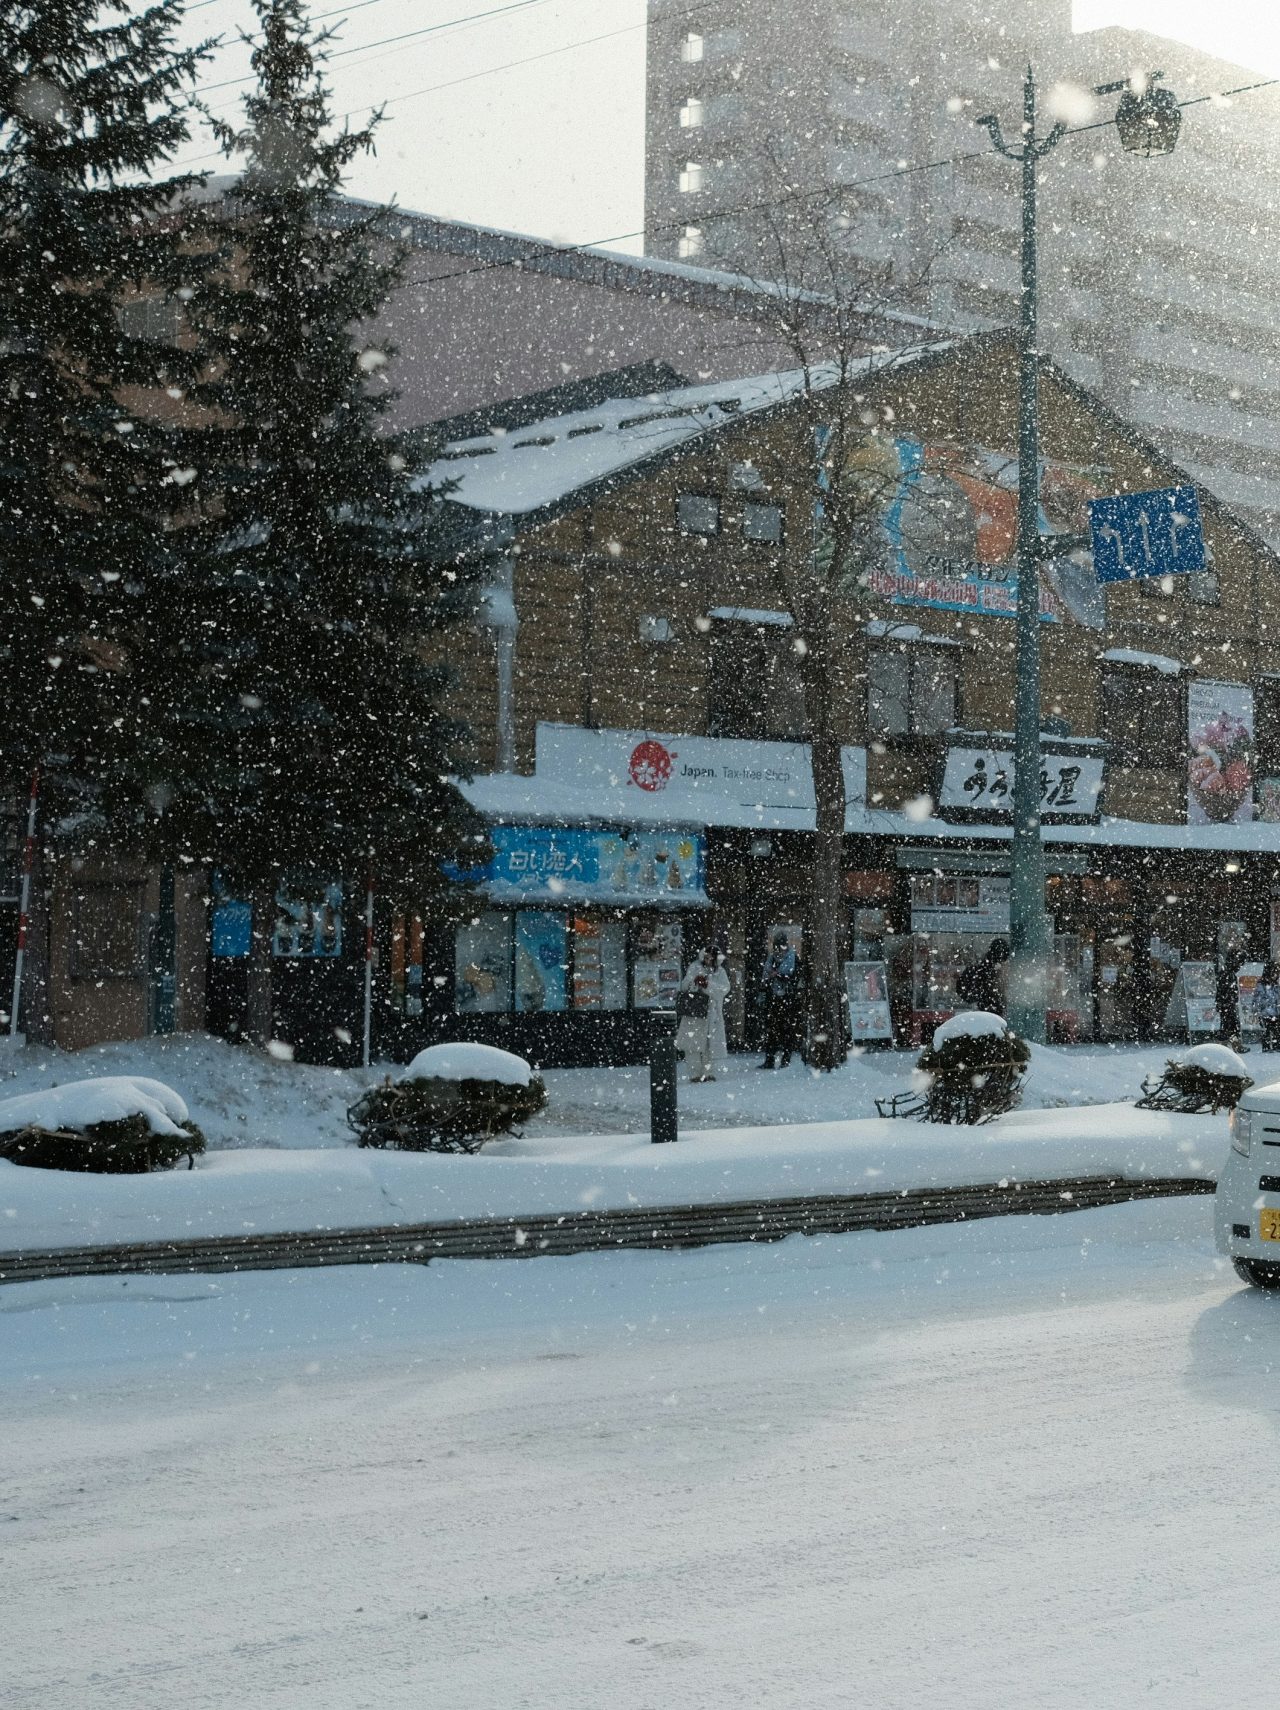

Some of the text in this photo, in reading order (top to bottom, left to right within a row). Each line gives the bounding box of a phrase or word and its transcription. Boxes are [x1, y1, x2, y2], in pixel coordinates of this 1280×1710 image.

[680, 763, 791, 784] Japan. Tax-free Shop
[508, 849, 584, 874] 白い恋人
